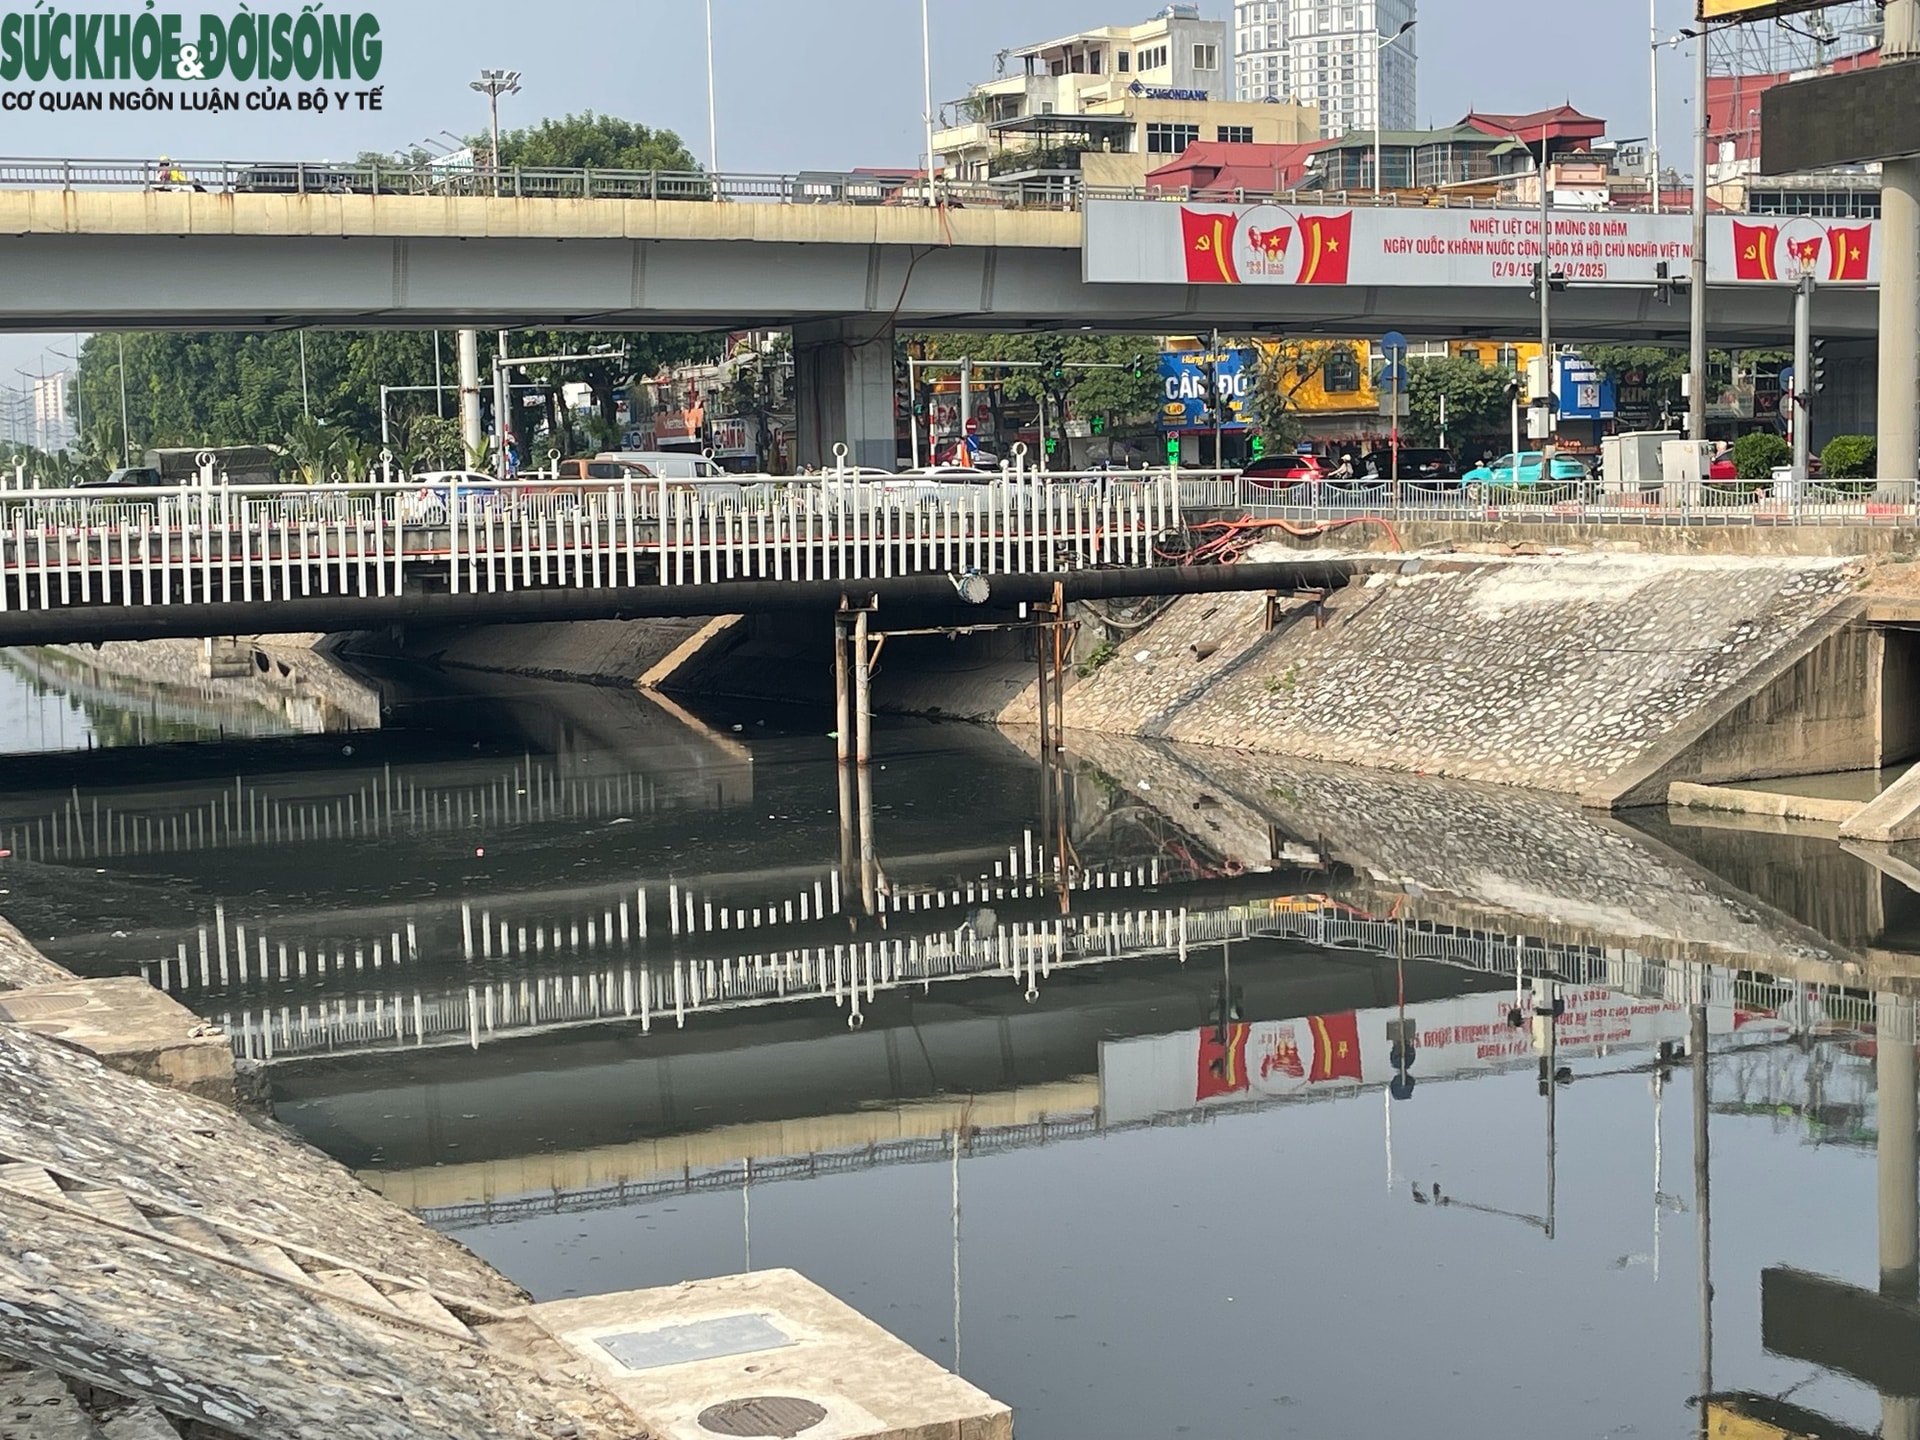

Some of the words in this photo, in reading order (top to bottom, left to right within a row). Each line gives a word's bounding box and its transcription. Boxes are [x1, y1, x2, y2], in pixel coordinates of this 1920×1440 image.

[1145, 88, 1208, 101] SAIGONBANK
[1470, 217, 1499, 237] NHIỆT
[1502, 218, 1522, 238] LIỆT
[1525, 220, 1552, 235] CHO
[1555, 219, 1585, 236] MỪNG
[1589, 222, 1600, 236] 80
[1603, 220, 1627, 236] NĂM
[1383, 236, 1413, 254] NGÀY
[1416, 235, 1445, 254] QUỐC
[1448, 238, 1483, 255] KHÁNH
[1486, 238, 1514, 255] NƯỚC
[1517, 239, 1543, 258] CỘN
[1548, 239, 1569, 256] HÒA
[1571, 240, 1583, 256] XÃ
[1587, 240, 1602, 258] HỘI
[1605, 239, 1624, 257] CHỦ
[1627, 241, 1657, 257] NGHĨA
[1660, 241, 1680, 260] VIỆT
